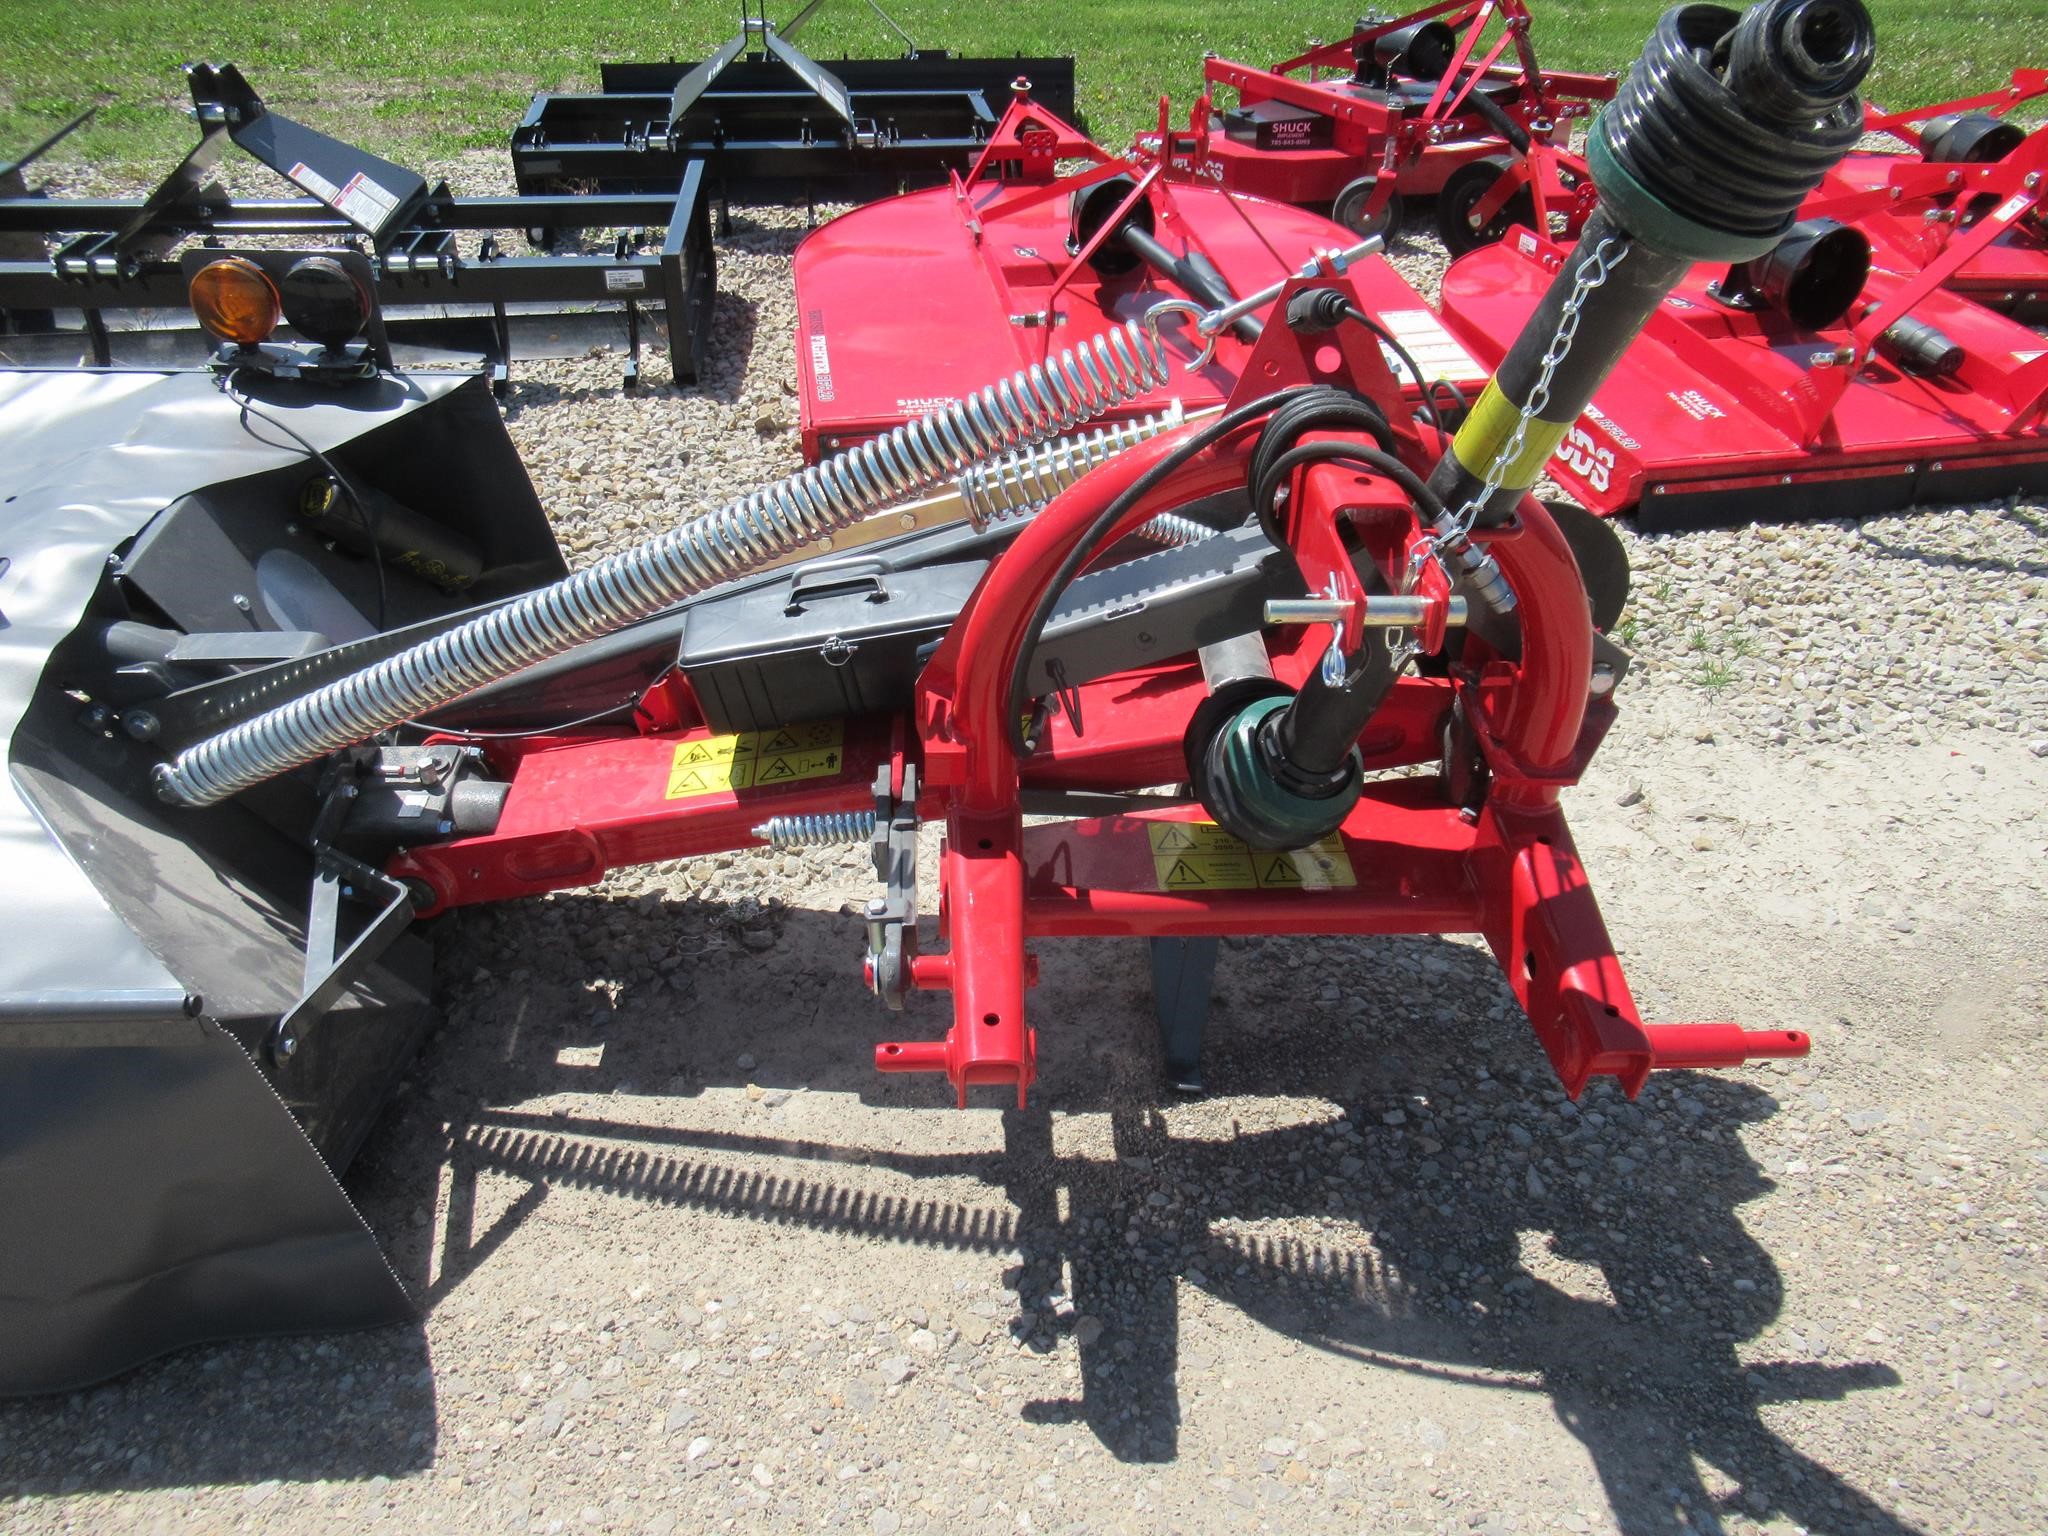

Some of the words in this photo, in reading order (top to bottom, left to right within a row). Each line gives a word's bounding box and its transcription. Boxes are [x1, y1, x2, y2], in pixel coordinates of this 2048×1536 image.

[1272, 121, 1312, 133] SHUCK
[896, 396, 955, 407] SHUCK
[1681, 390, 1727, 419] SHUCK
